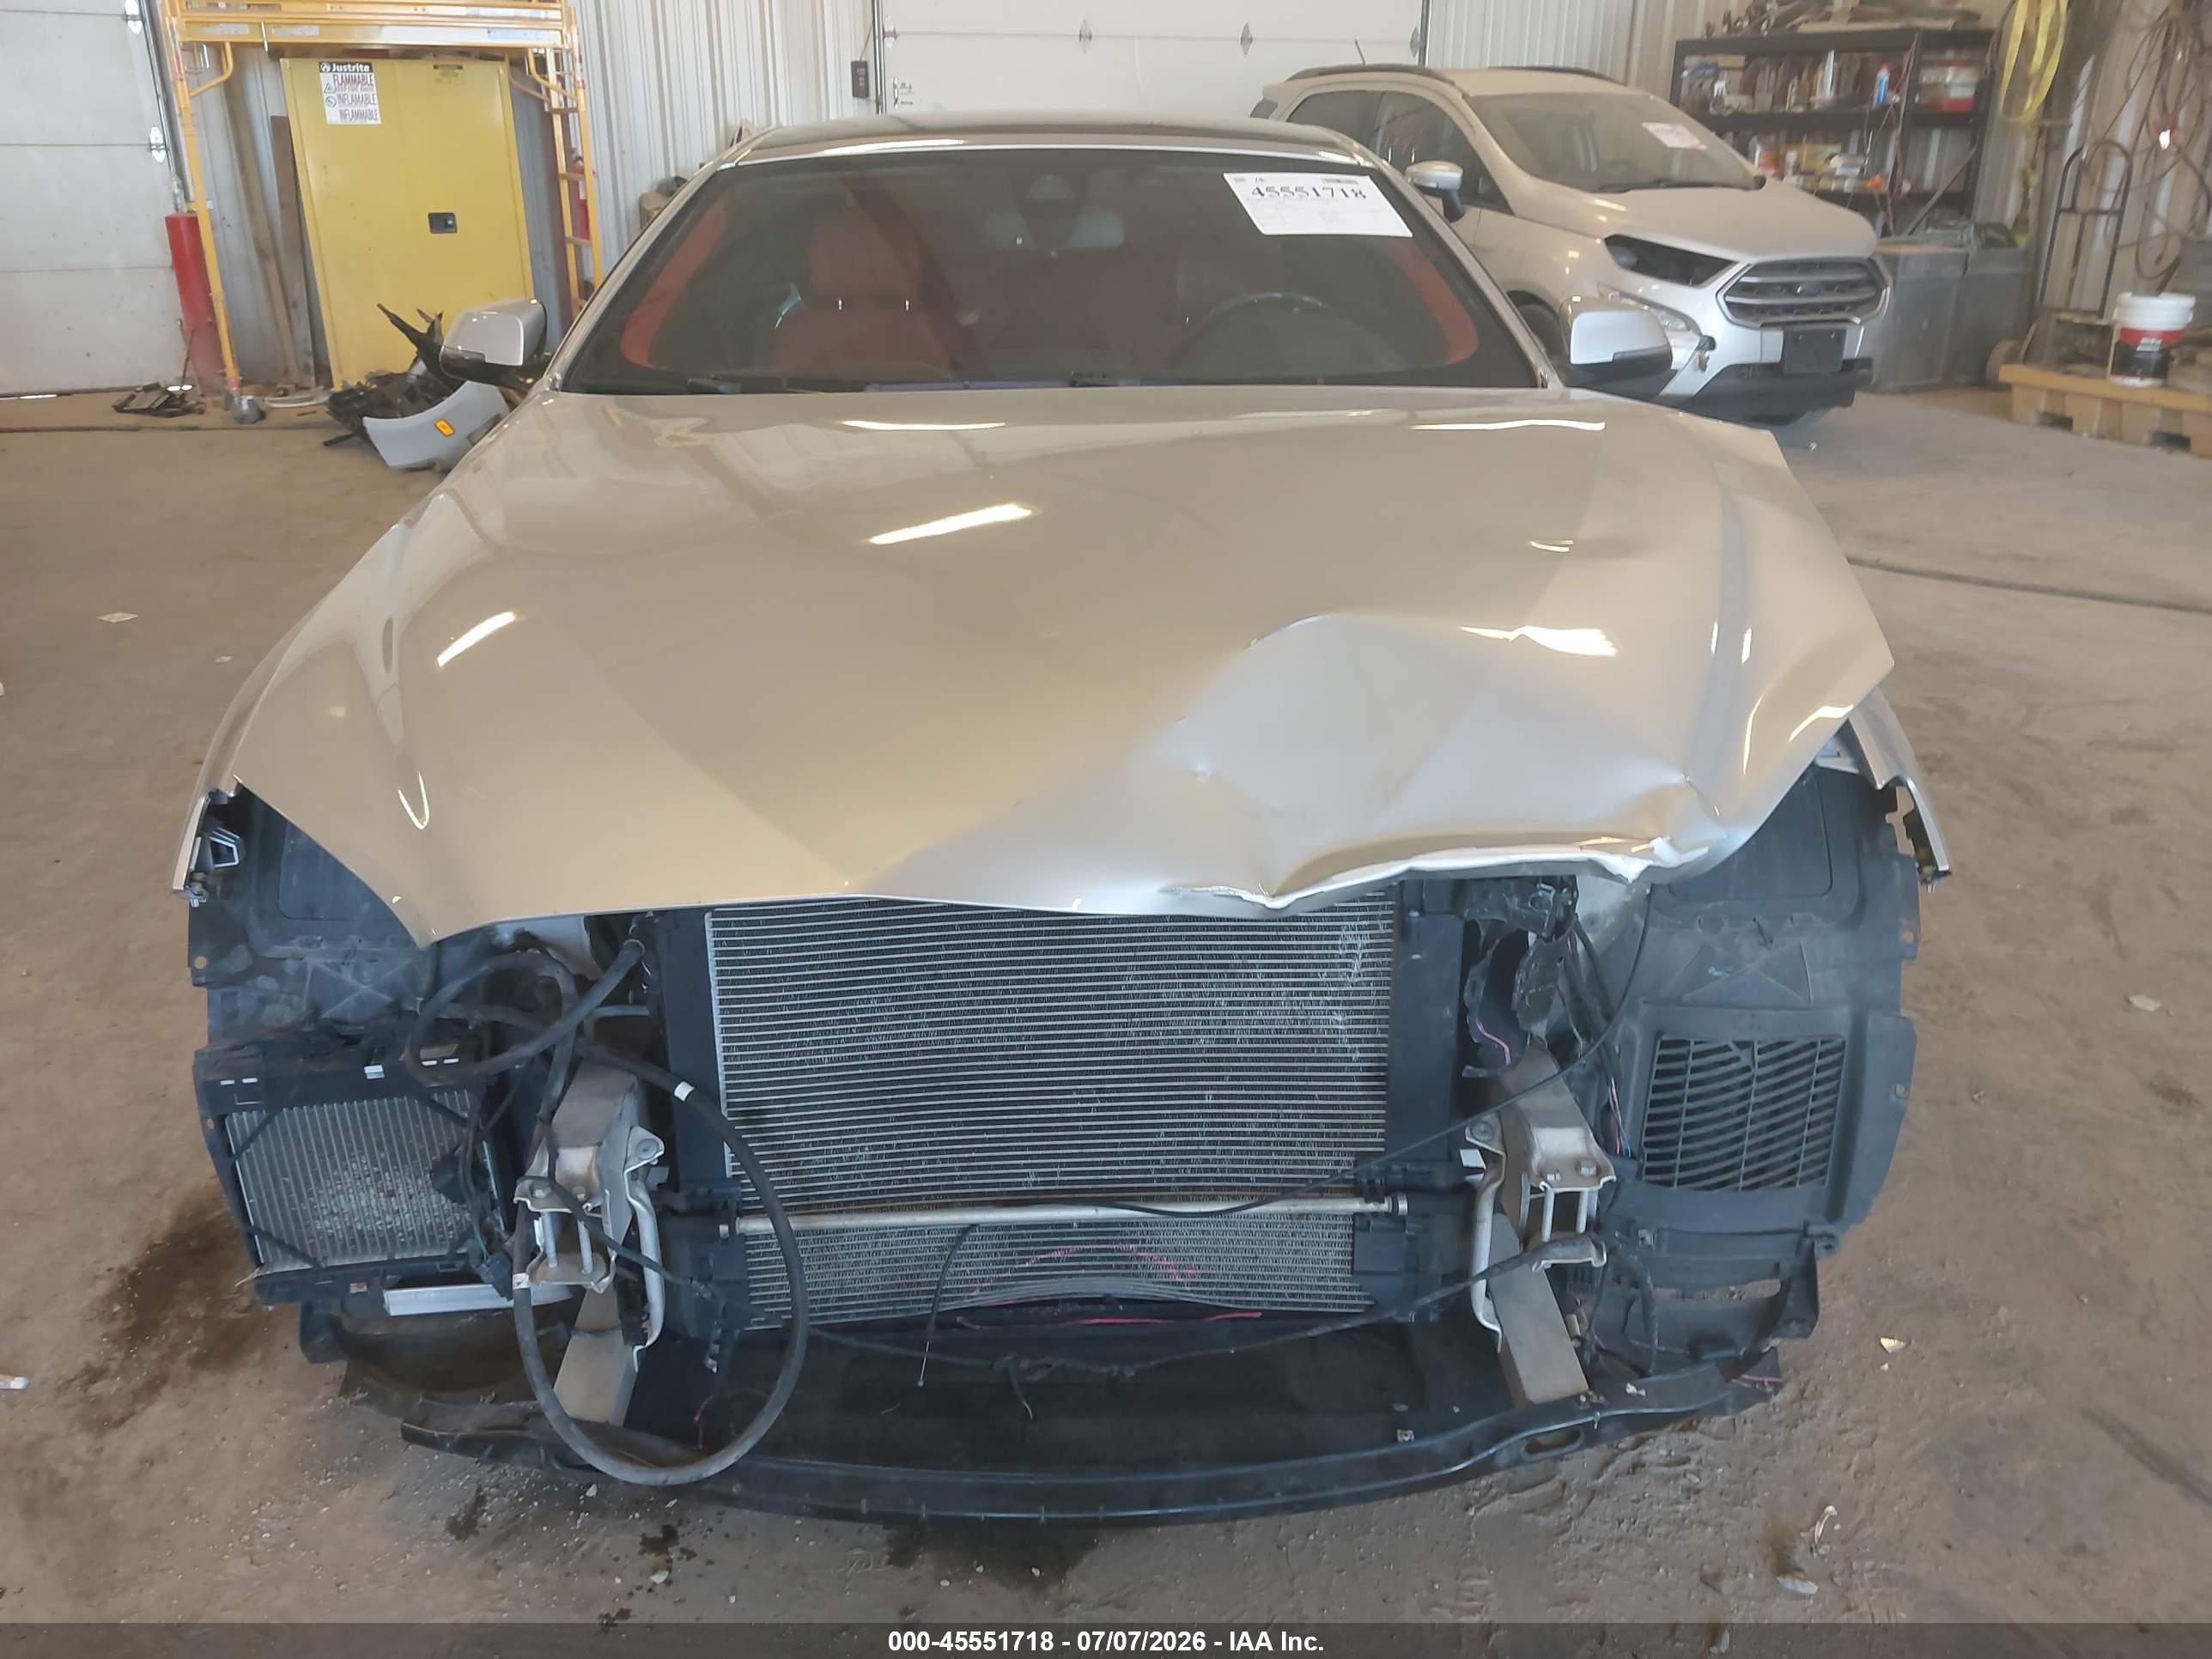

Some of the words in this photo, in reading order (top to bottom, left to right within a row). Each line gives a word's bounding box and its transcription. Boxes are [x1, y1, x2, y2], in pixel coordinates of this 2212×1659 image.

[332, 63, 371, 72] Justrite
[332, 74, 374, 86] FLAMMABLE
[337, 93, 377, 105] INFLAMABLE
[339, 108, 379, 121] INFLAMMABLE
[1251, 185, 1367, 199] 45551718
